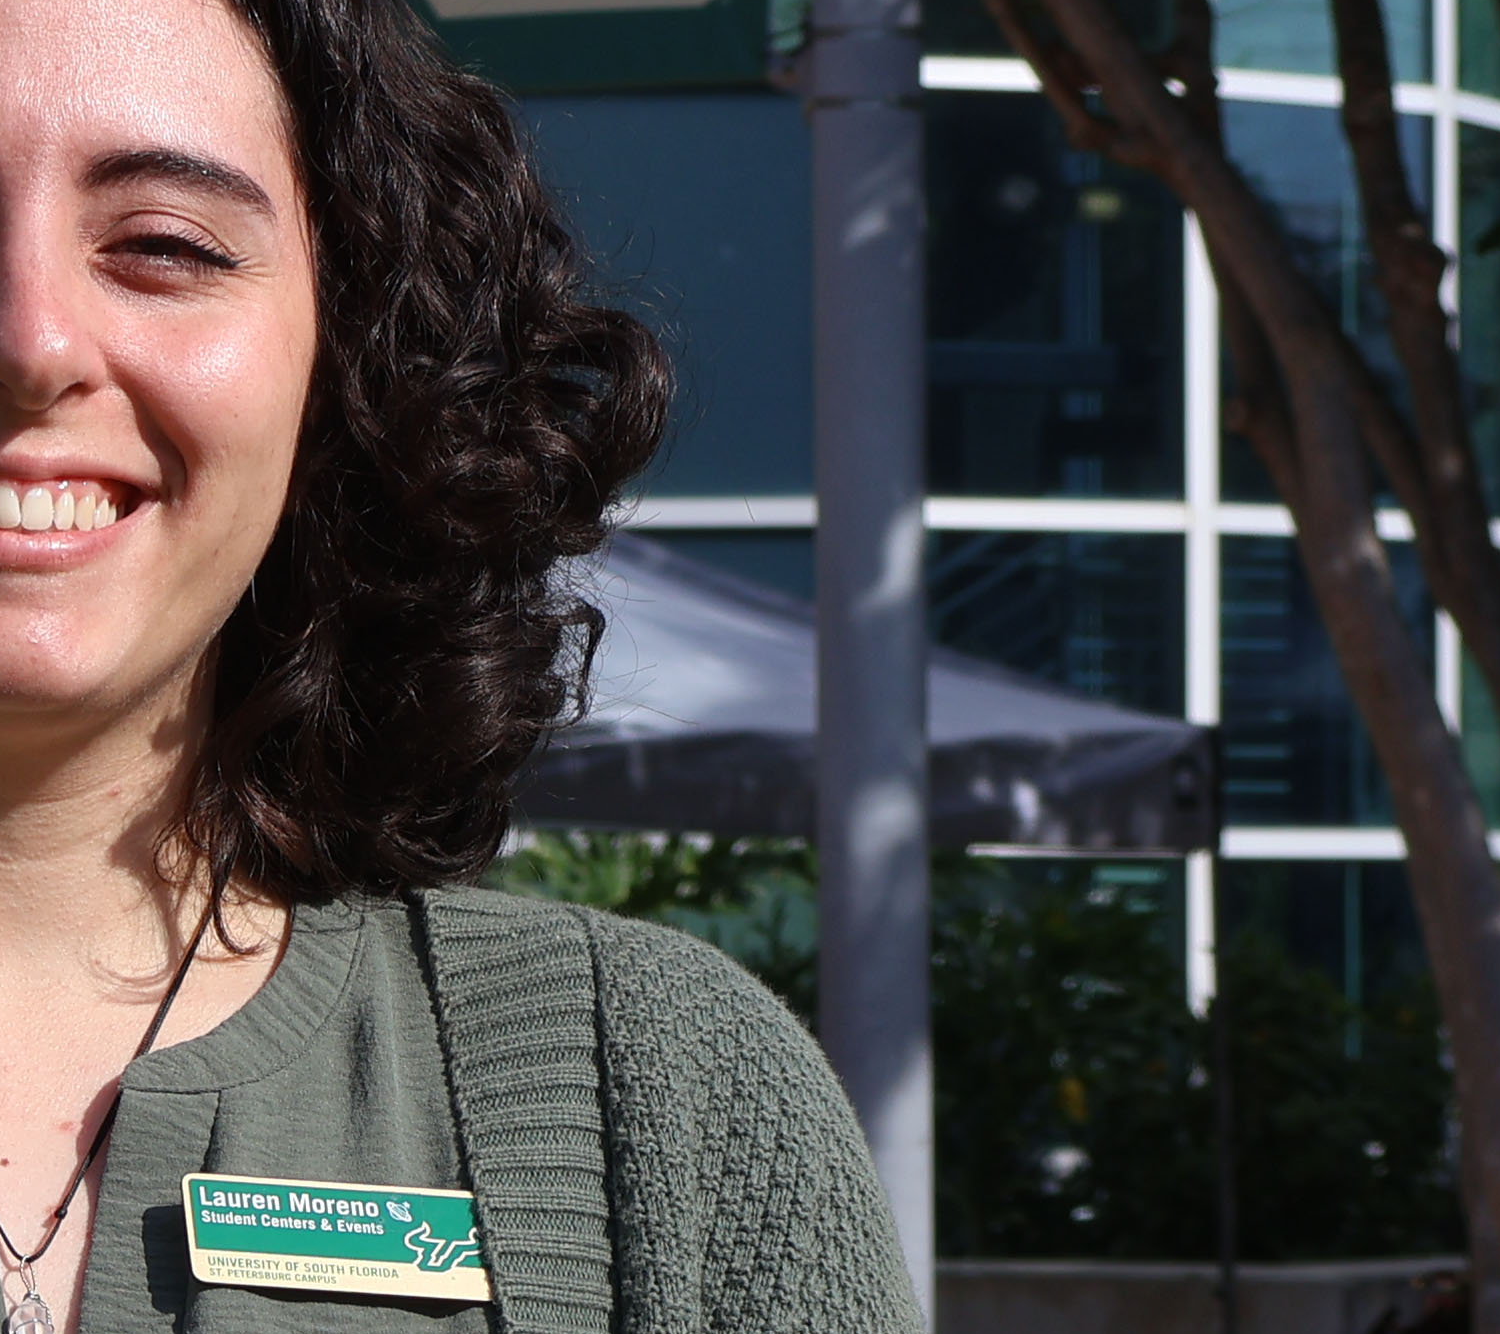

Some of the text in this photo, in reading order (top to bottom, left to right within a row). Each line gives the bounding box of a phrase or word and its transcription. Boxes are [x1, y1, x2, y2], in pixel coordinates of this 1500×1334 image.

[199, 1186, 380, 1218] Lauren Moreno
[201, 1210, 384, 1235] Student Centers & Events
[207, 1256, 399, 1279] UNIVERSITY OF SOUTH FLORIDA
[209, 1268, 337, 1284] ST. PETERSBURG CAMPUS
